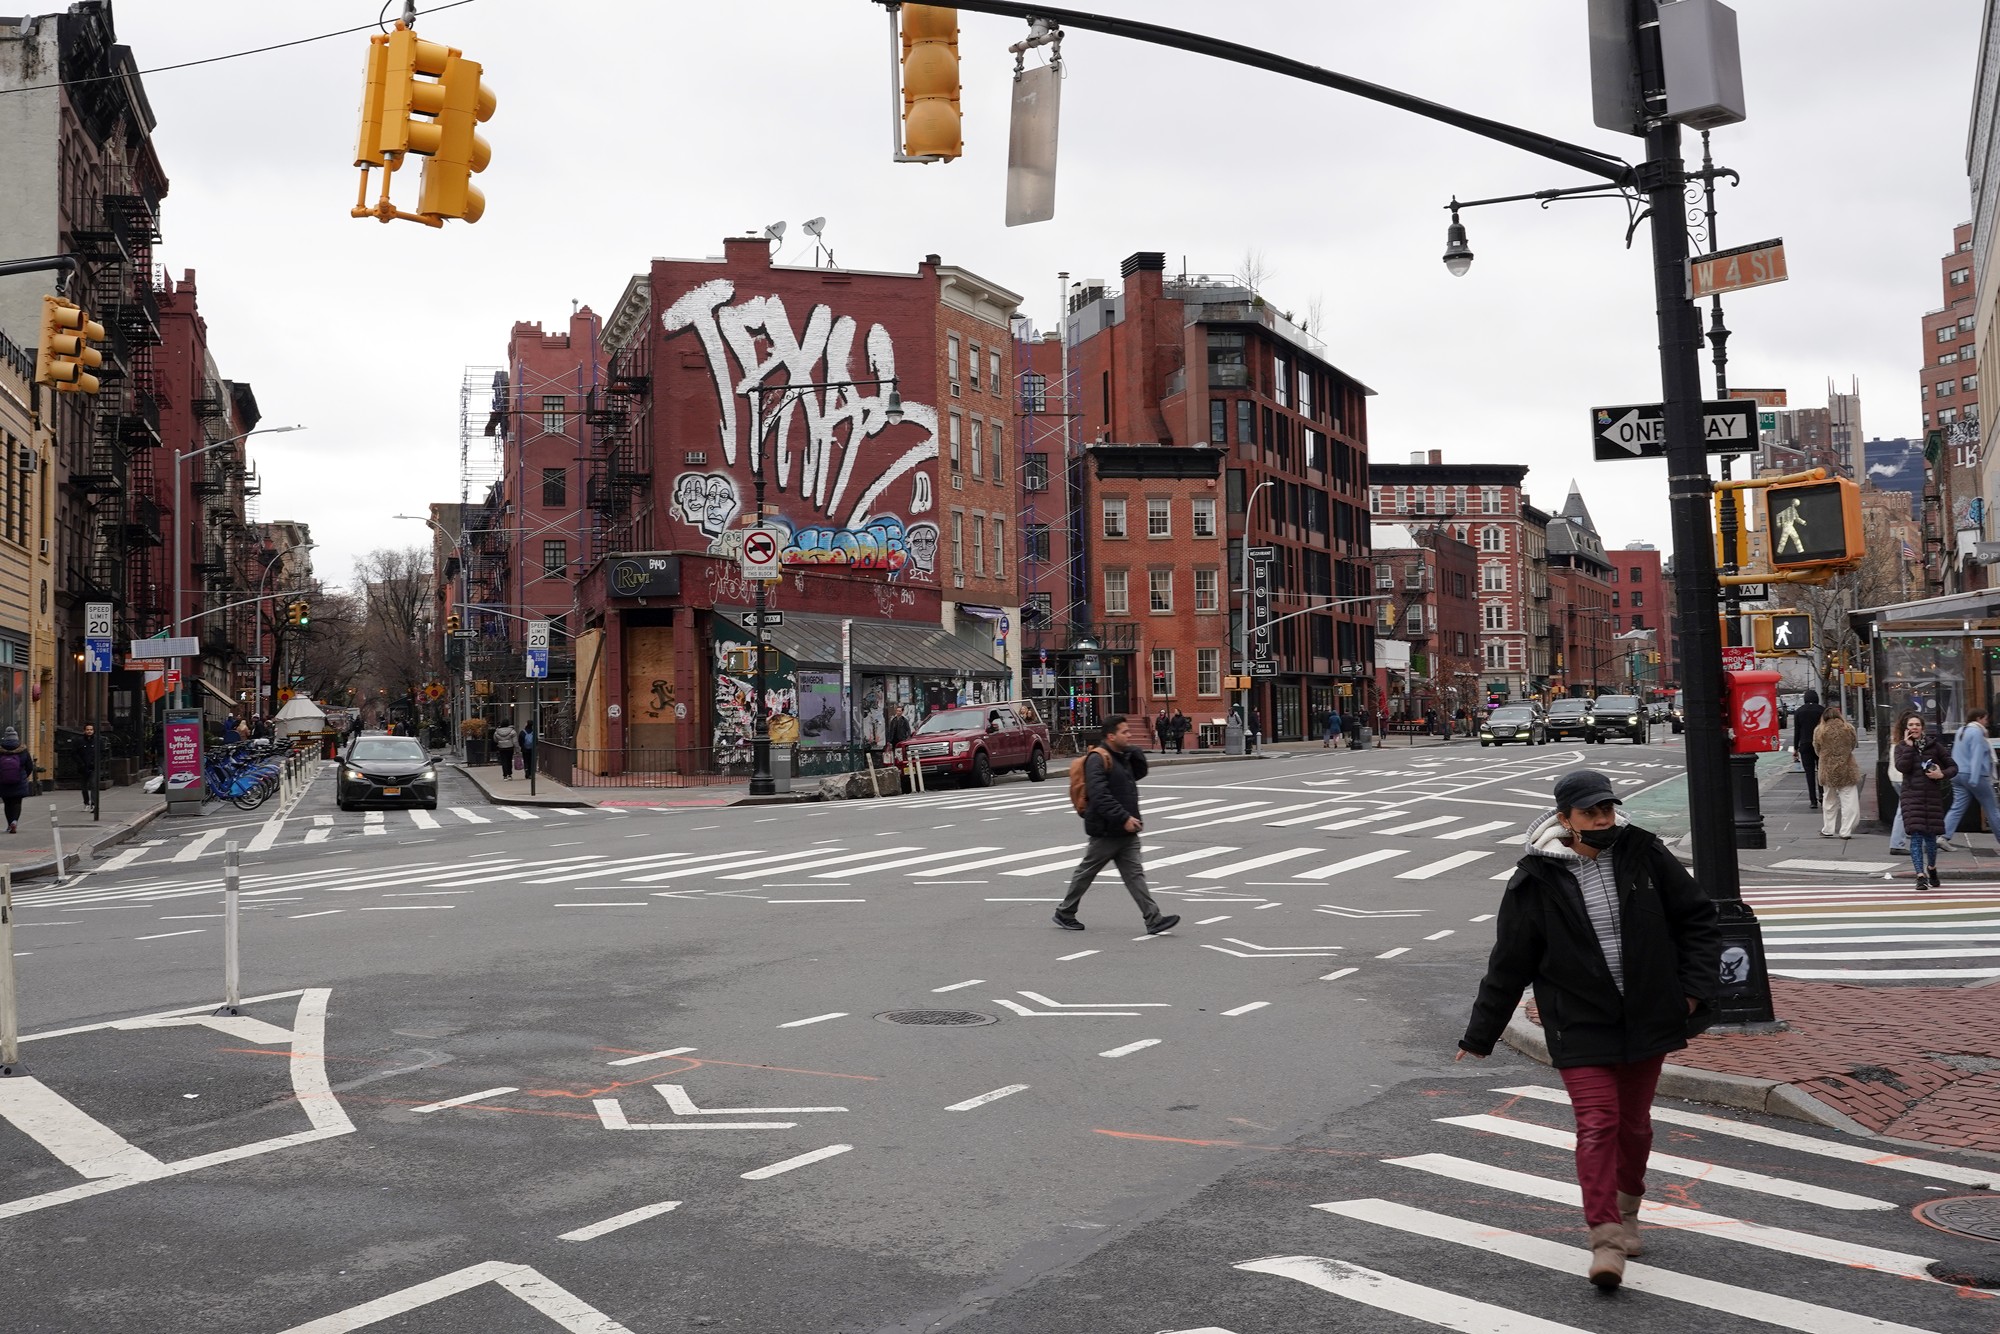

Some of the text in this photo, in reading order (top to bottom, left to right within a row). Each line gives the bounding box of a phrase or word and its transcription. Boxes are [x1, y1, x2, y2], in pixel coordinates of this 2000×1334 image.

[1697, 250, 1775, 289] W 4 ST
[1703, 417, 1737, 438] AY
[89, 621, 109, 634] 20
[530, 635, 546, 646] 20
[173, 735, 192, 743] Wait,
[168, 742, 183, 750] Lyft
[1586, 760, 1686, 769] ONLY
